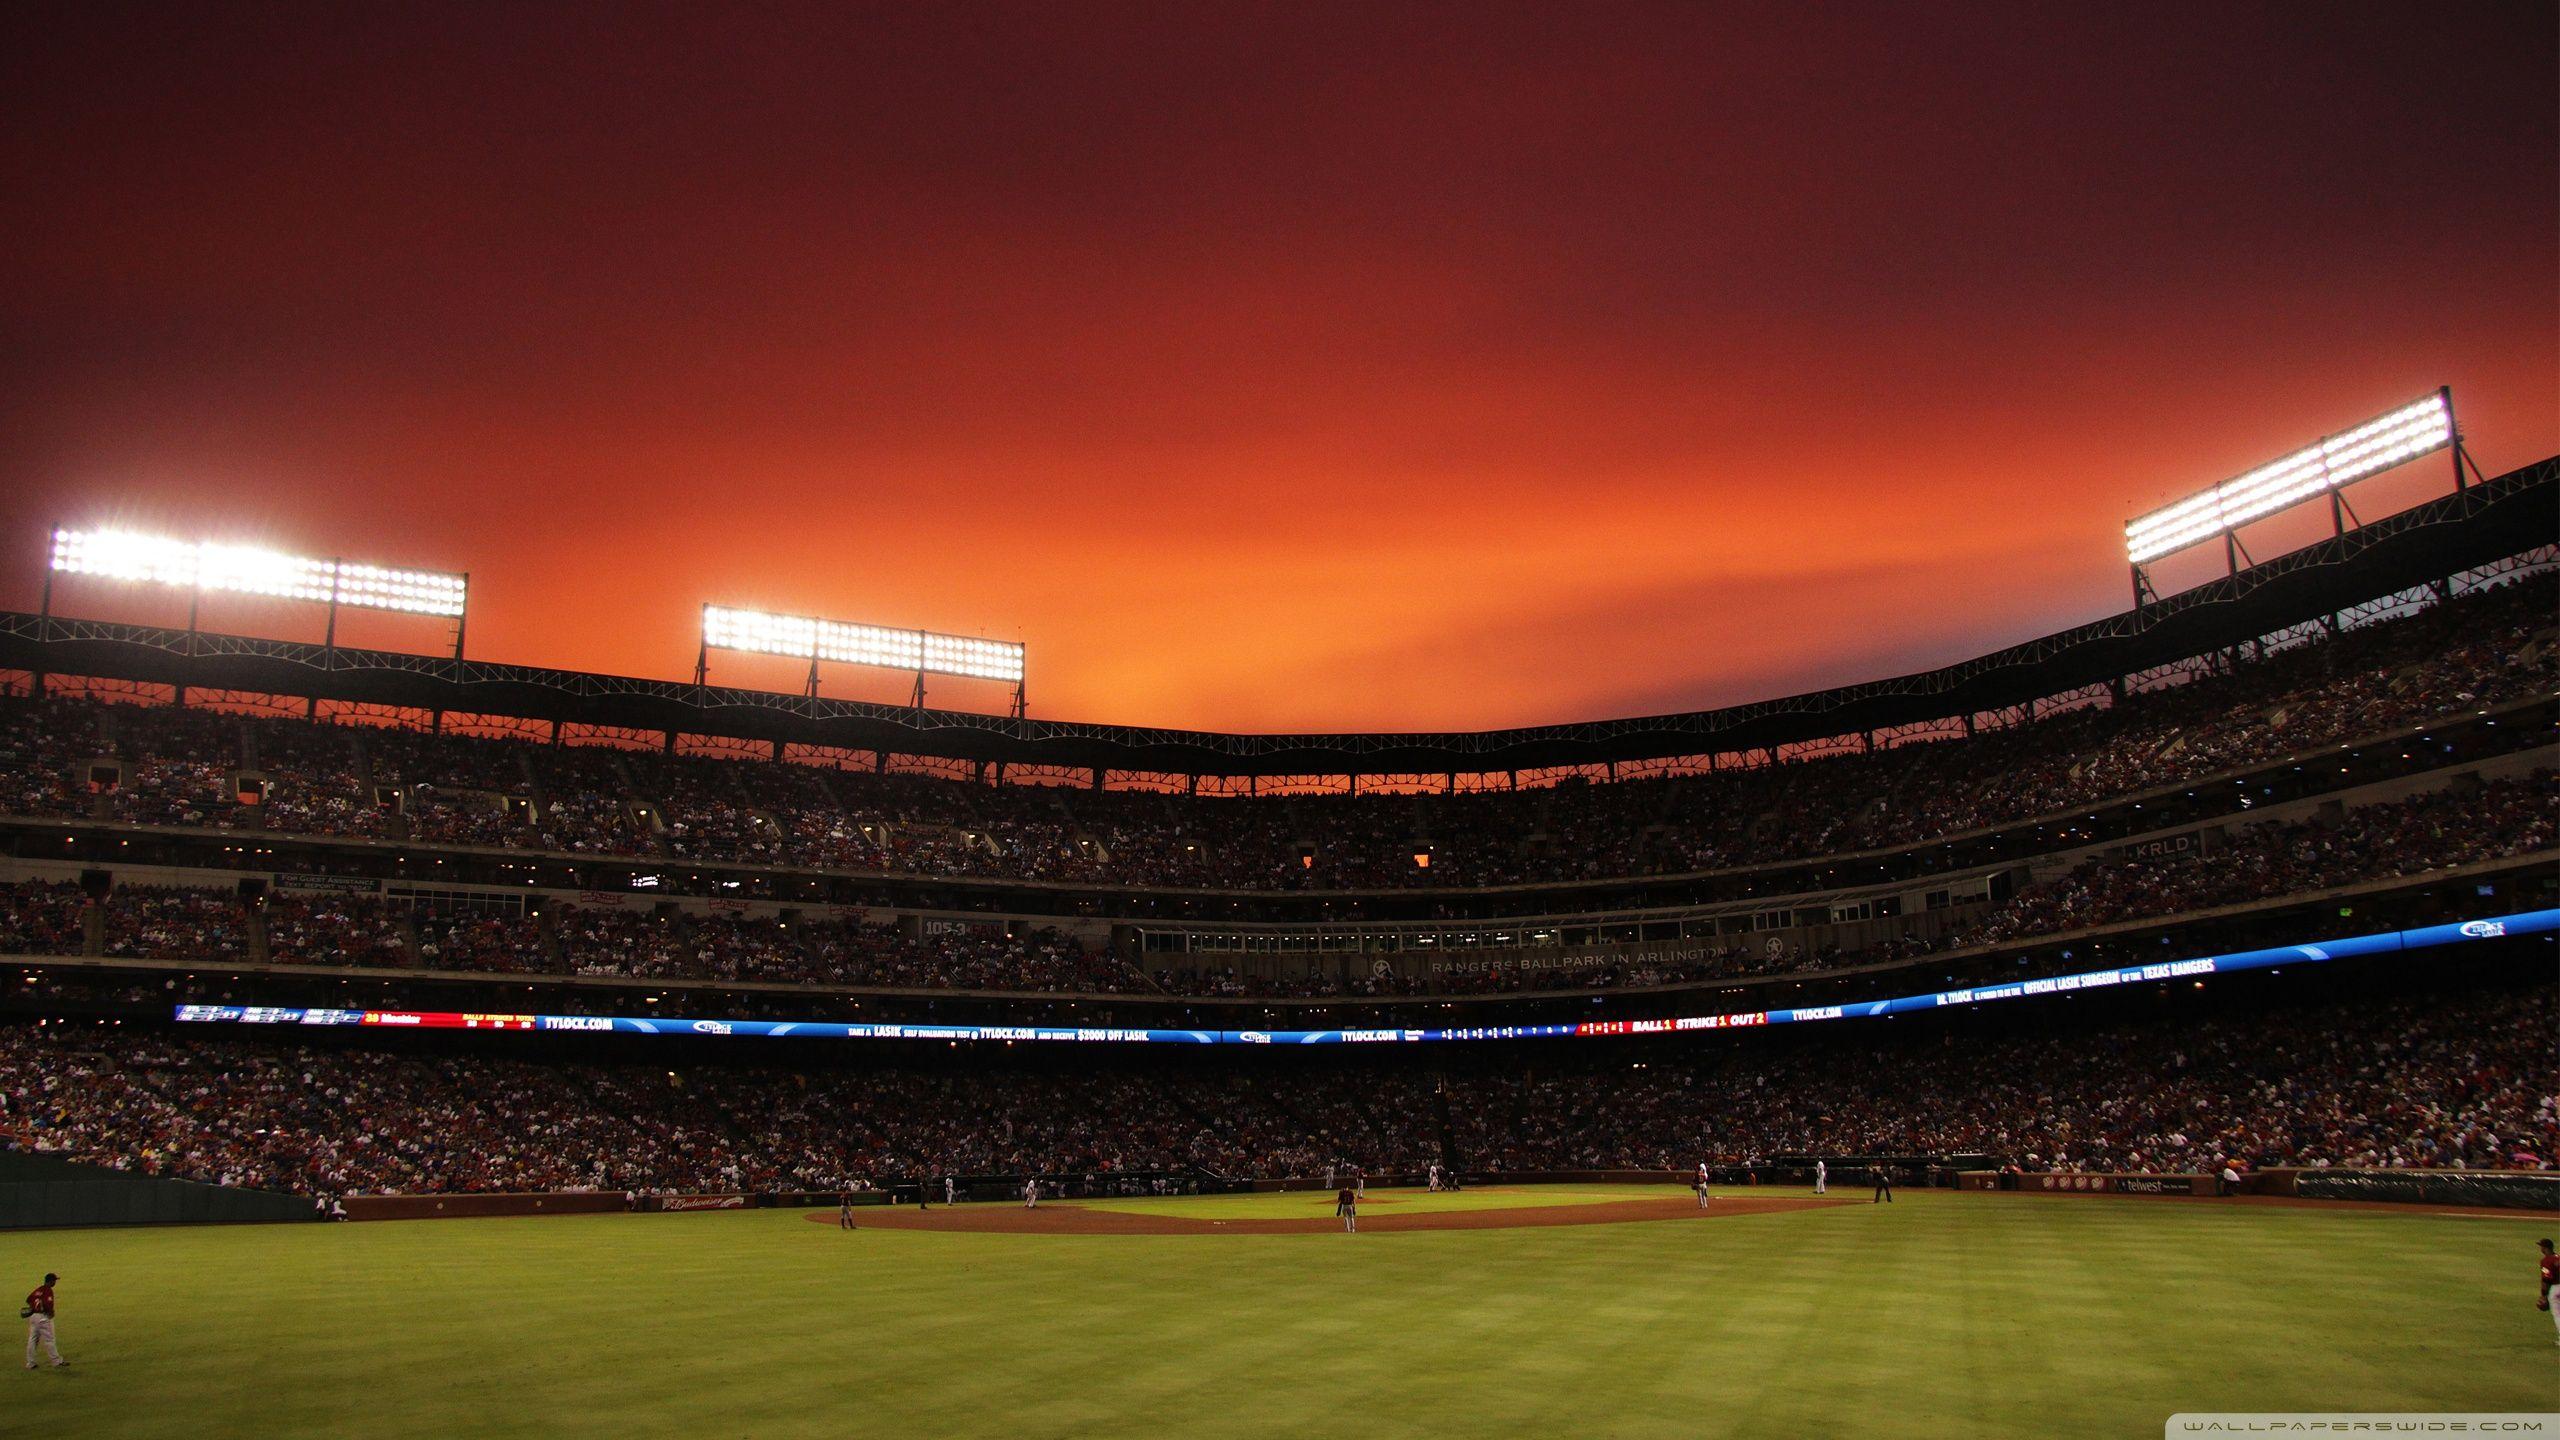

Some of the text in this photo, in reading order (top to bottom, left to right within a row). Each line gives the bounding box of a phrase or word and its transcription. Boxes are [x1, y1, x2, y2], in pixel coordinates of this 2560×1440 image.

[2136, 837, 2189, 858] KRLD
[926, 920, 965, 936] 105.3
[1432, 946, 1728, 973] RANGERS BALLPARK IN ARLINGTON
[1948, 990, 1972, 1004] TYLOCK
[2023, 978, 2057, 994] OFFICIAL
[2057, 974, 2080, 991] LASIK
[2081, 970, 2120, 988] SURGEON
[2142, 964, 2170, 979] TEXAS
[2171, 959, 2216, 976] RANGERS
[1792, 1006, 1842, 1021] TYLOCK.COM
[545, 1017, 613, 1030] TYLOCK.COM
[1632, 1012, 1764, 1031] BALL 1 STRIKE 1 OUT 2
[848, 1028, 865, 1036] TAKE
[874, 1026, 901, 1037] LASIK
[918, 1030, 956, 1038] EVALUATION
[980, 1028, 1036, 1039] TYLOCK.COM
[1077, 1029, 1106, 1041] $2000
[1107, 1030, 1123, 1041] OFF
[1341, 1030, 1397, 1041] TYLOCK.COM
[2127, 1179, 2162, 1192] telwest
[674, 1197, 722, 1208] Budweiser
